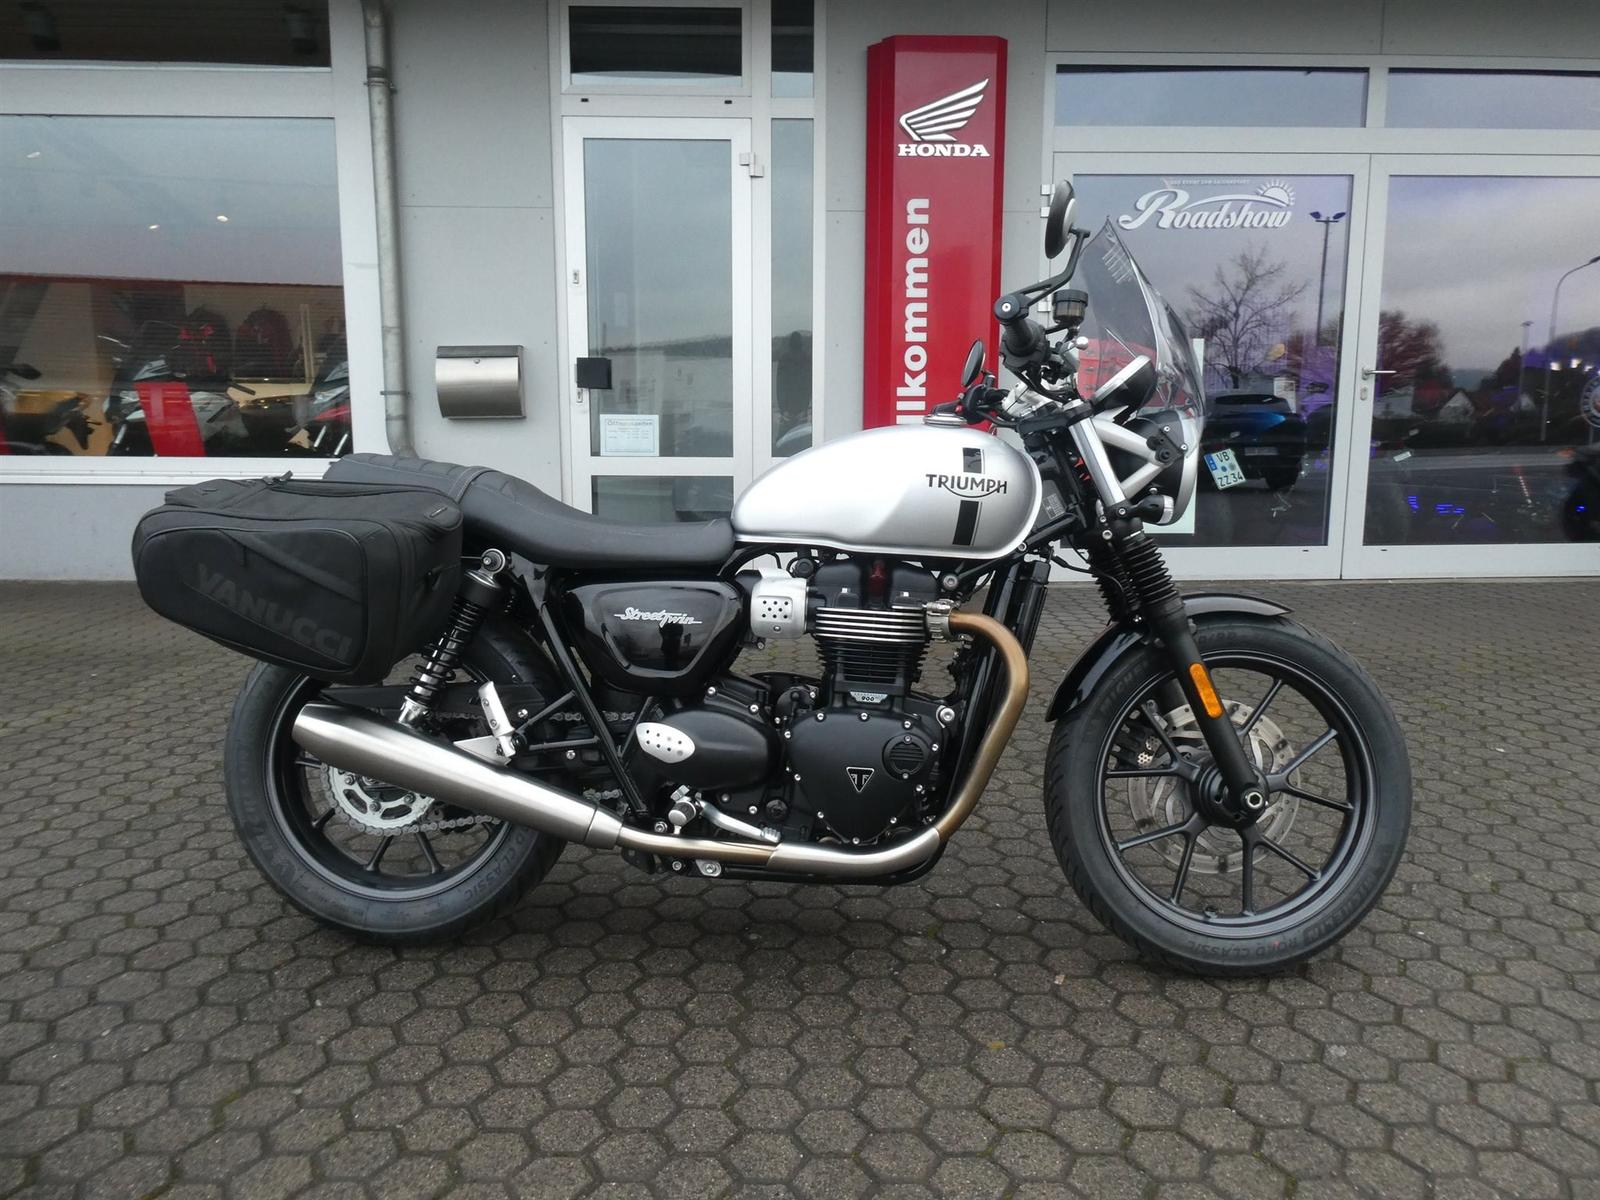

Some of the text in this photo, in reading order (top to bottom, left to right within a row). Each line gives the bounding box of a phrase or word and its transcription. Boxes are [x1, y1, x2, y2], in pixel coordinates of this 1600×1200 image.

[898, 144, 990, 157] HONDA
[1118, 188, 1292, 229] Roadshow
[896, 198, 929, 425] llkommen
[1216, 451, 1230, 463] VB
[925, 473, 1008, 498] TRIUMPH
[198, 562, 353, 660] VANUCCI
[1187, 939, 1250, 960] CLASSIC
